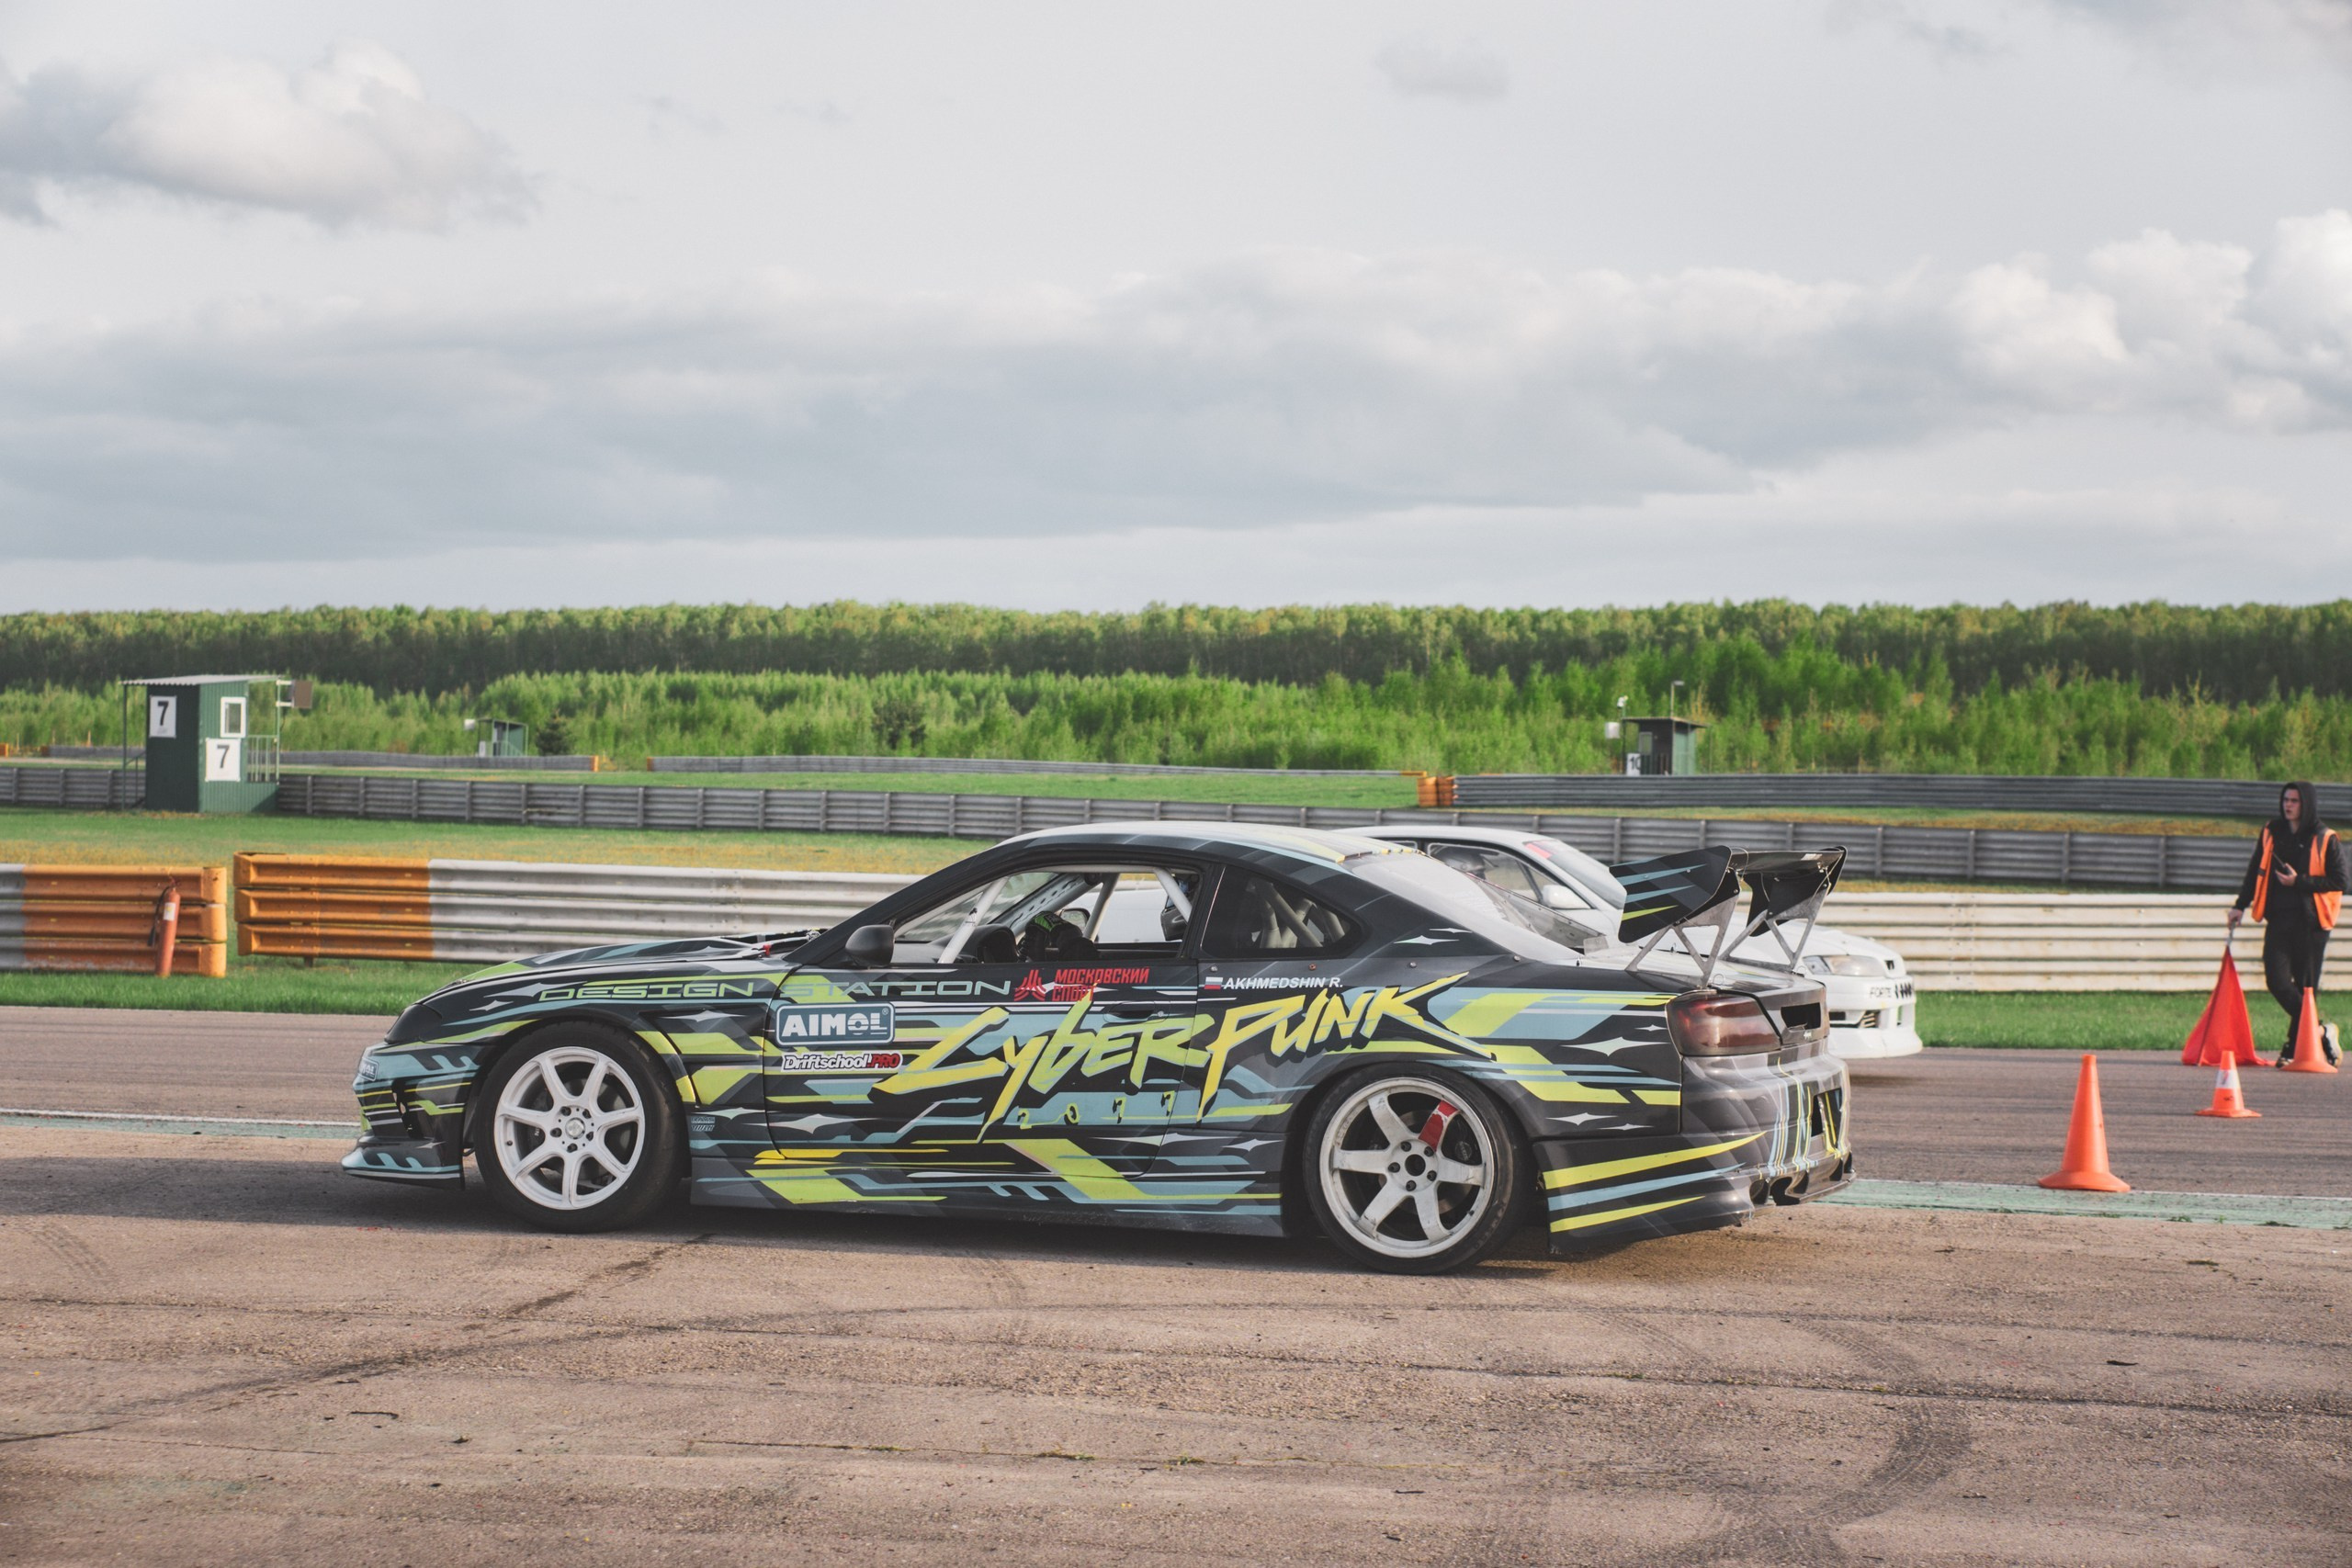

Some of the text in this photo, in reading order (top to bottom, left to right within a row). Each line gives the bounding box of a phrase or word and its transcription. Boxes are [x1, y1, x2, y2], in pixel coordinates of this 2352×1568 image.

[157, 700, 169, 726] 7
[217, 744, 230, 769] 7
[1055, 966, 1150, 984] МОСКОВСКИЙ
[1223, 976, 1343, 989] AKHMEDSHIN R.
[538, 980, 1011, 1001] DESIGN STATION
[1052, 986, 1096, 1001] СПОРТ
[781, 1013, 888, 1037] AIMOL
